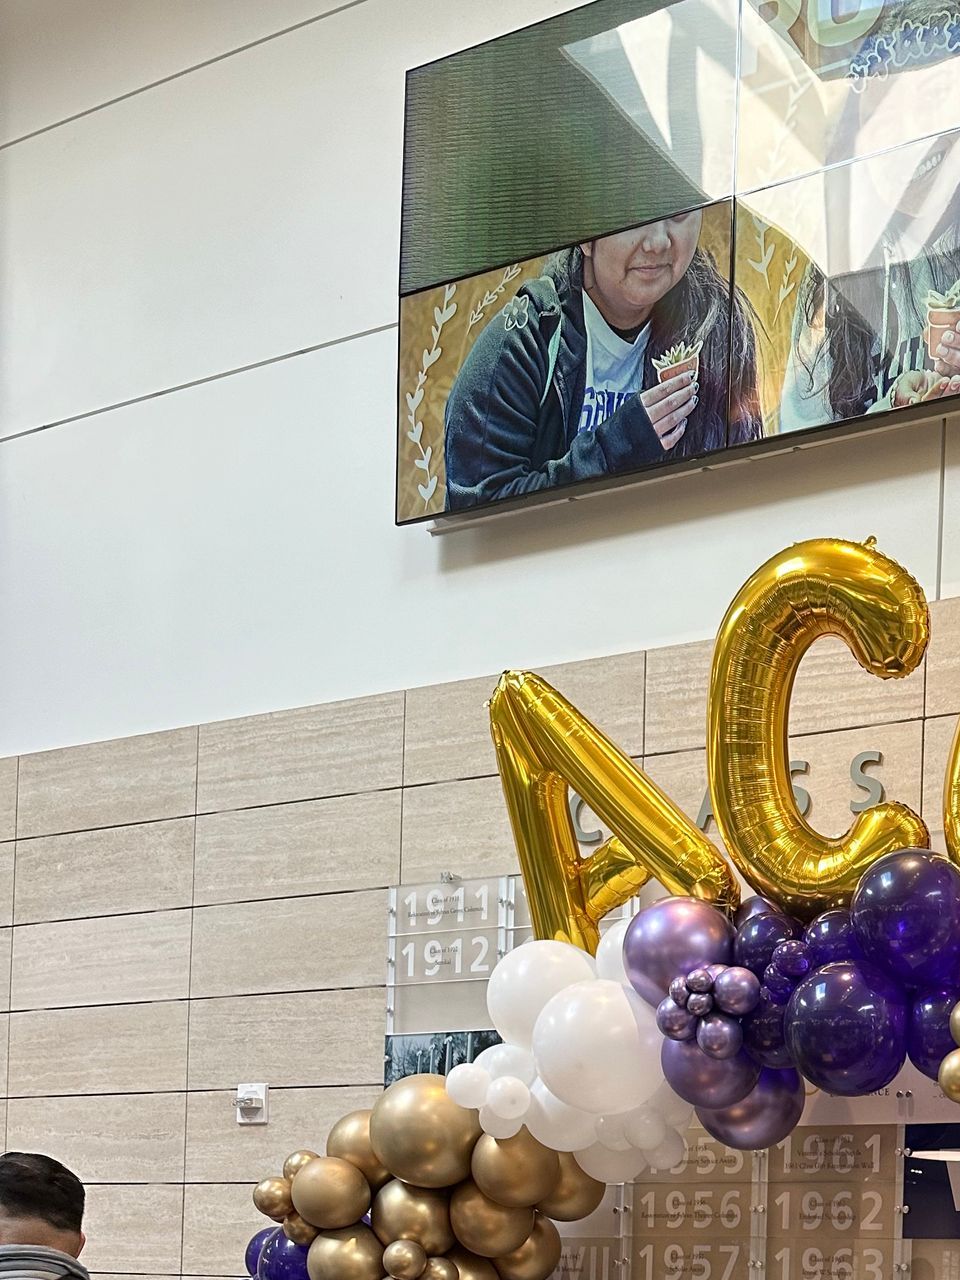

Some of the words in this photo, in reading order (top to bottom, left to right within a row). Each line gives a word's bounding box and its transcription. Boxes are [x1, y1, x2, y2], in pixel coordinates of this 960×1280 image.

[404, 885, 489, 926] 1911
[401, 936, 489, 977] 1912
[776, 1134, 881, 1174] 1961
[641, 1190, 741, 1228] 1956
[775, 1191, 883, 1230] 1962
